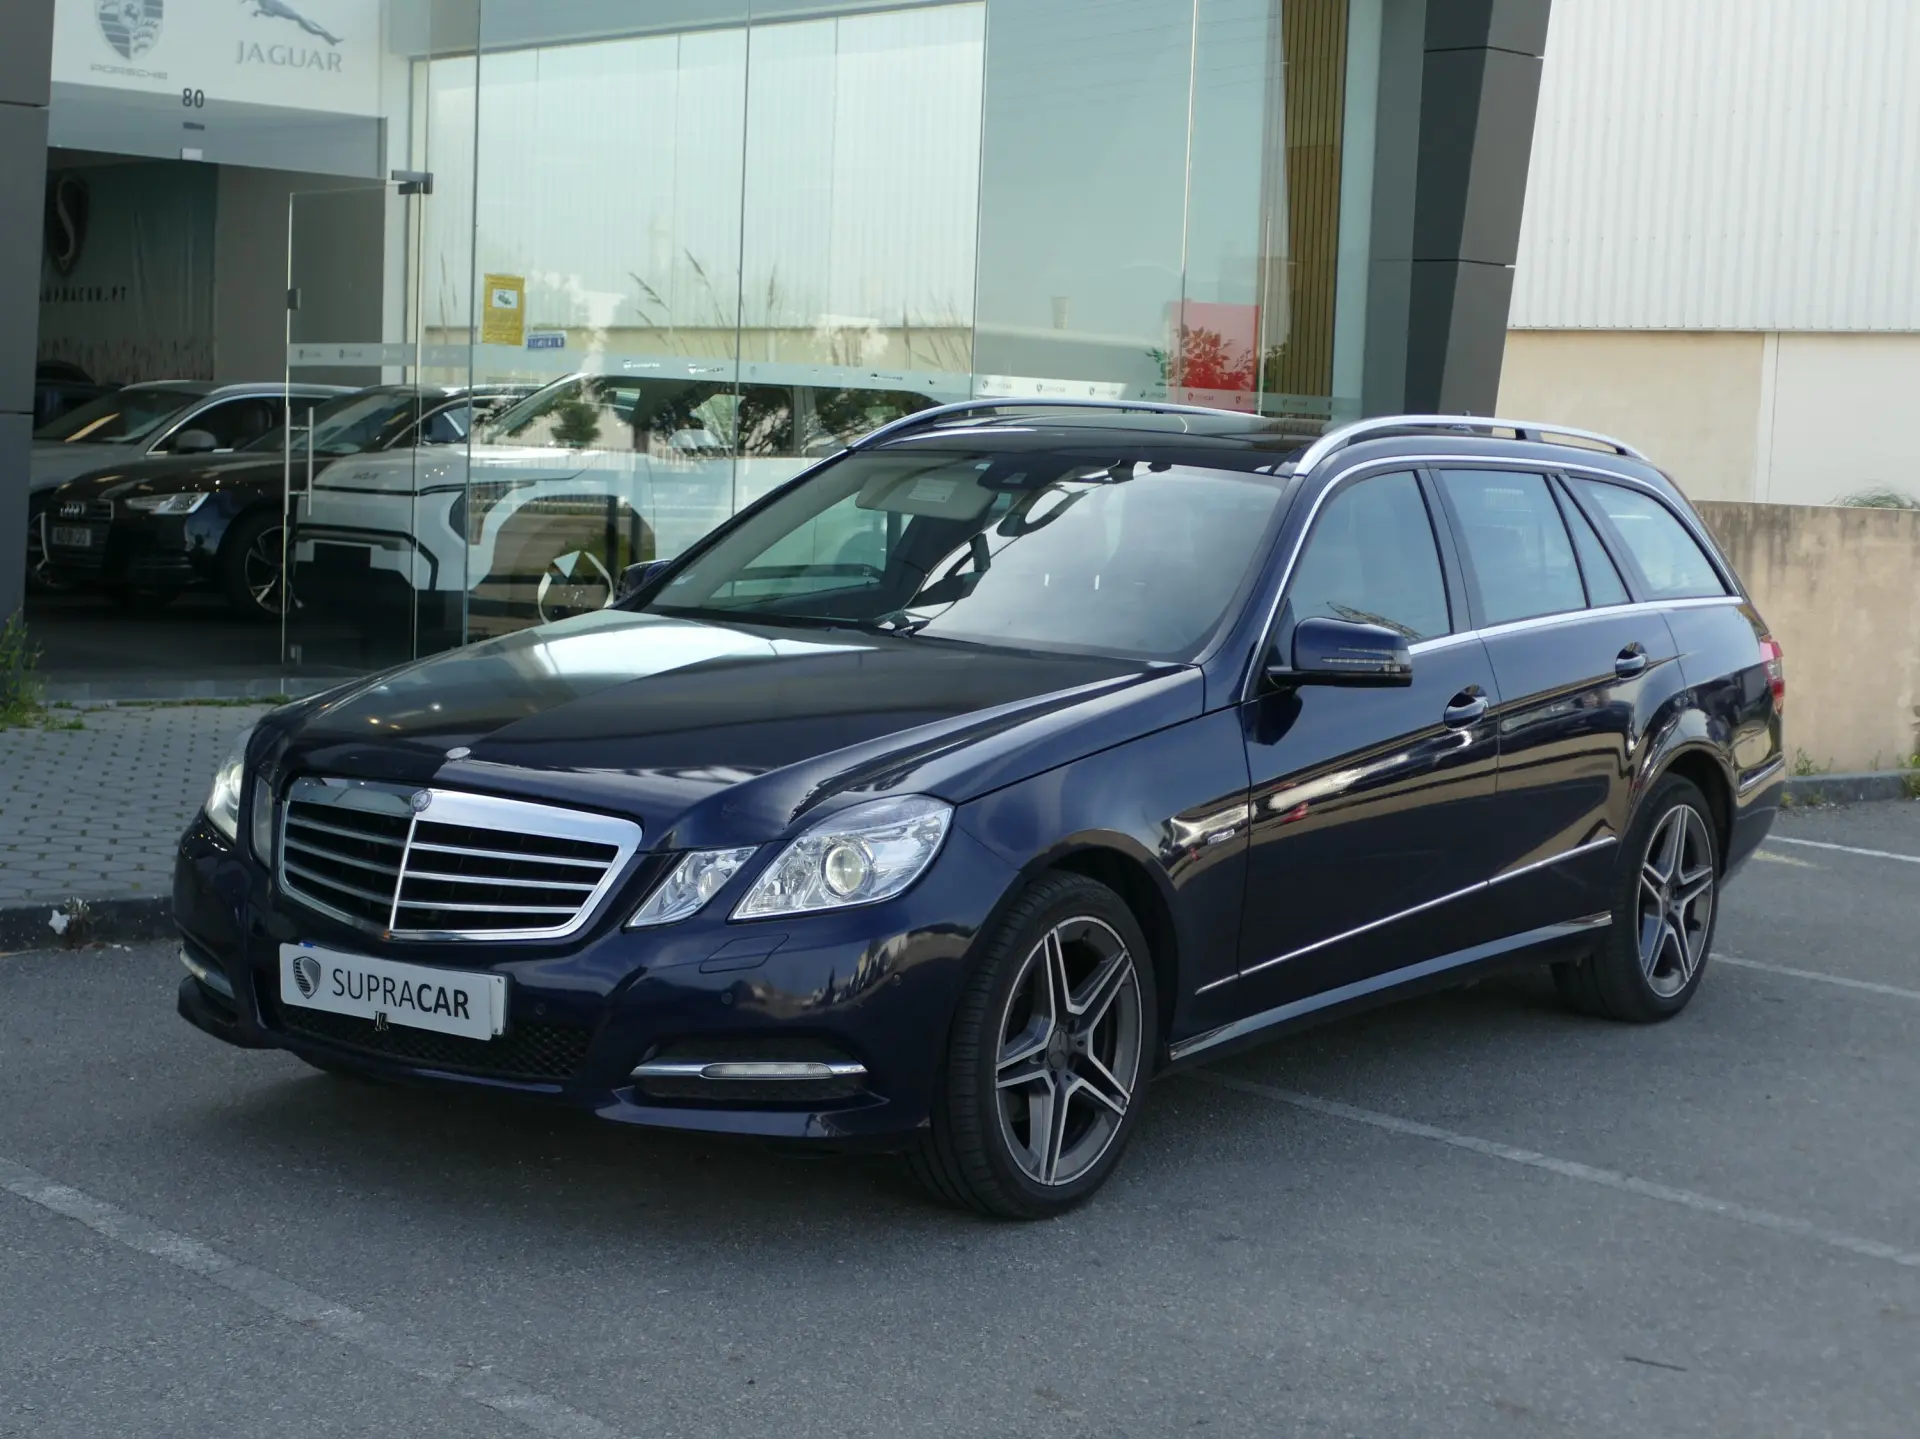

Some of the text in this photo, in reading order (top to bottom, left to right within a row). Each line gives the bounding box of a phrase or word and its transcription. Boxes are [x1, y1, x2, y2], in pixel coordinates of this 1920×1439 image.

[235, 41, 343, 73] JAGUAR
[90, 63, 168, 80] PORSCHE
[182, 87, 205, 109] 80
[332, 968, 470, 1020] SUPRACAR
